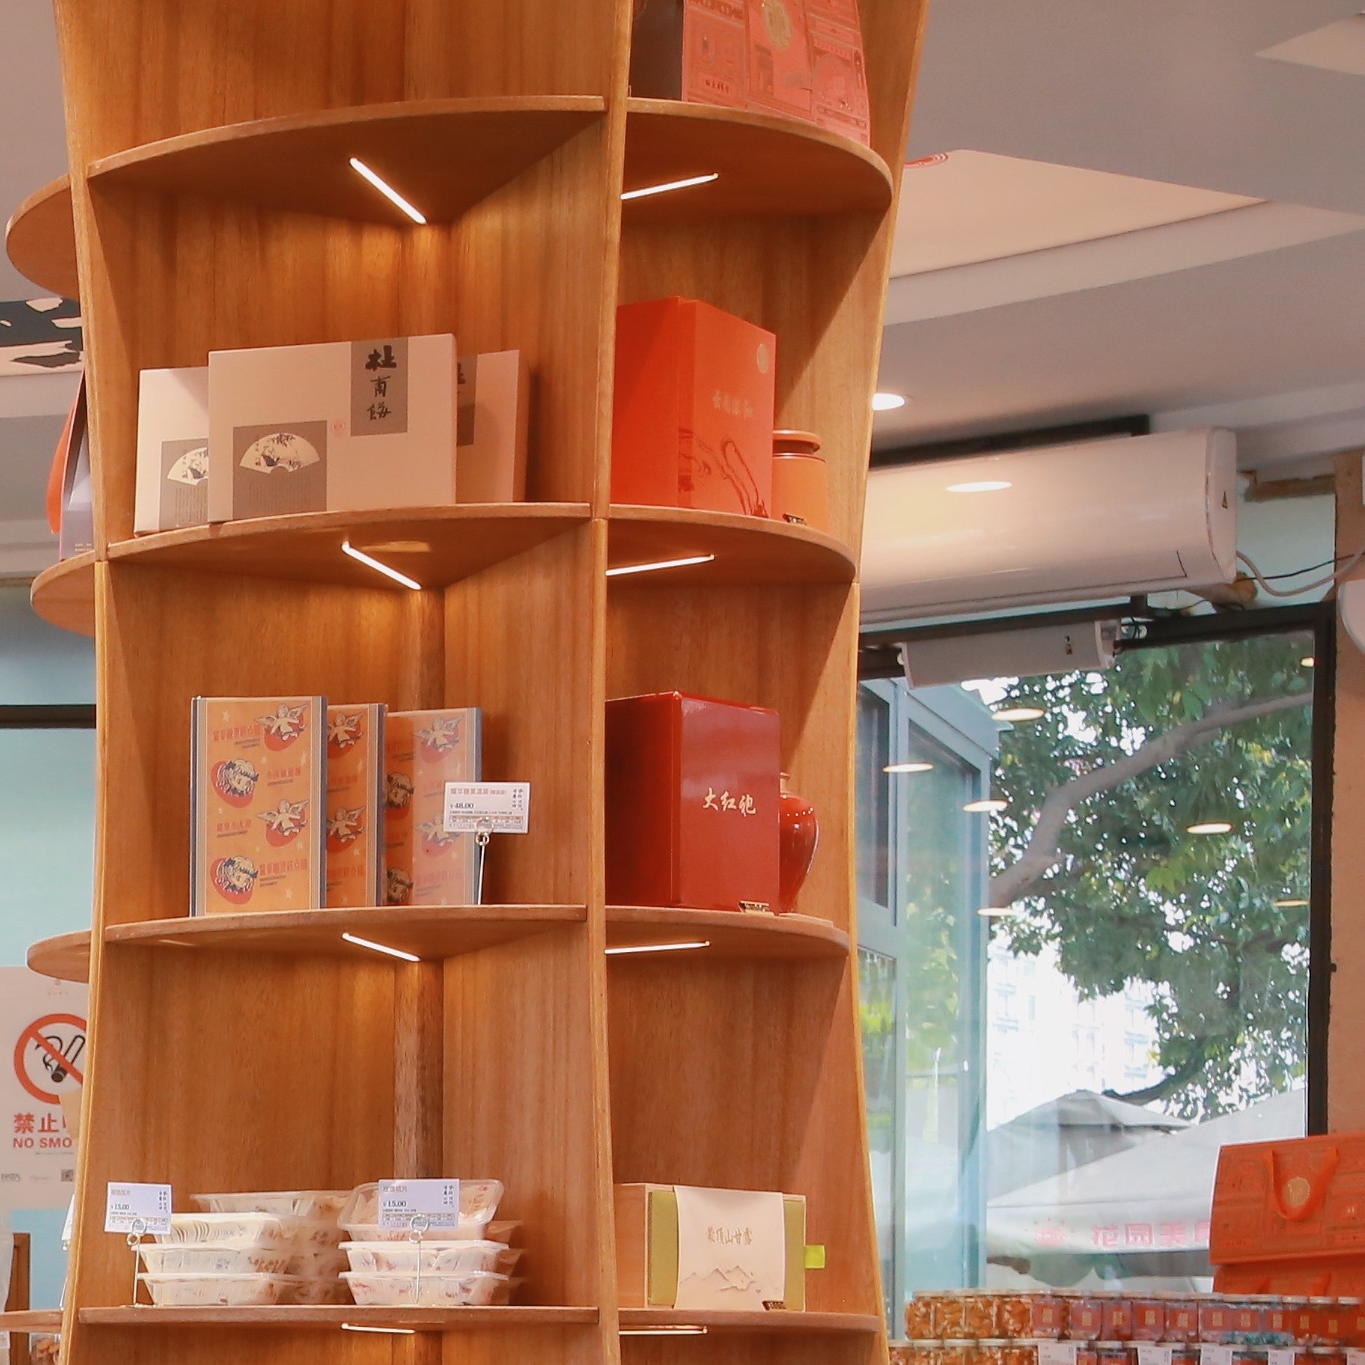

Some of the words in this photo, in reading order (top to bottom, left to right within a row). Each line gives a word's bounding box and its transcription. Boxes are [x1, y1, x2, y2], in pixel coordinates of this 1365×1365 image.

[702, 787, 756, 818] 大红袍
[13, 1112, 67, 1134] 禁止
[13, 1137, 35, 1149] NO
